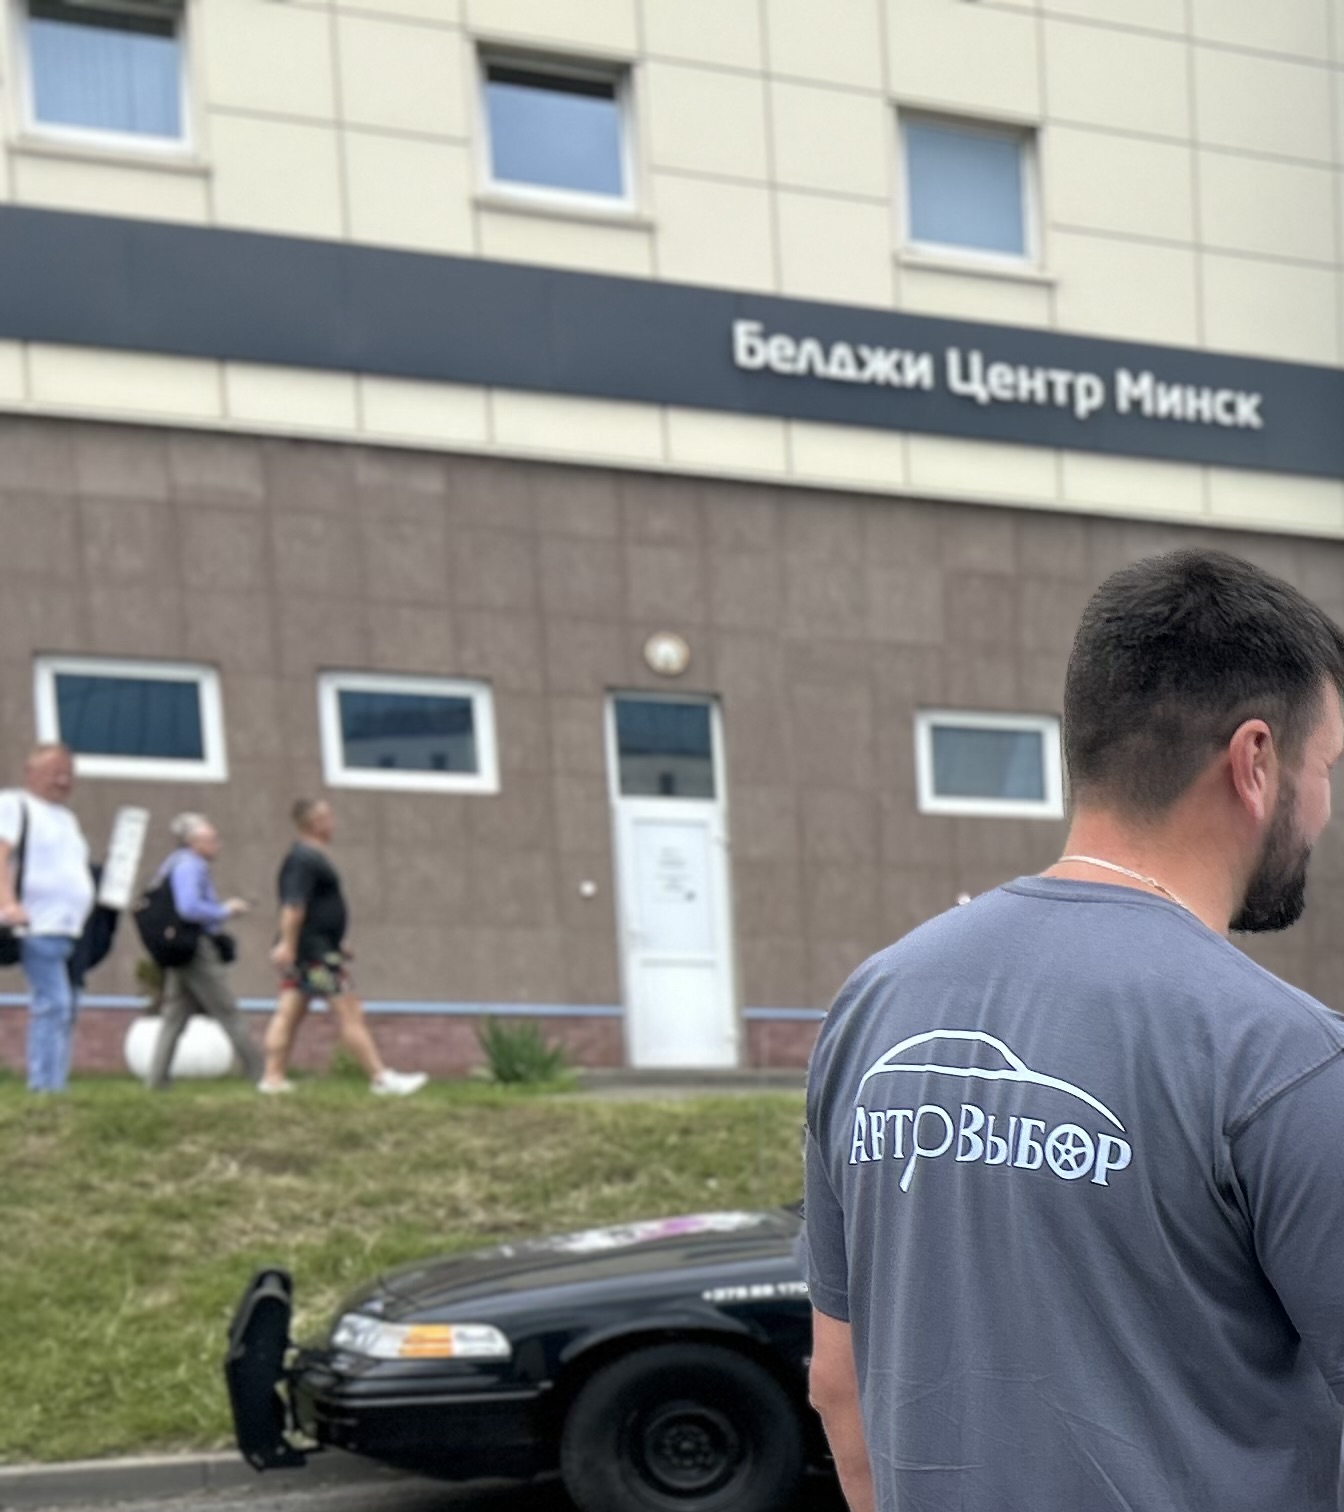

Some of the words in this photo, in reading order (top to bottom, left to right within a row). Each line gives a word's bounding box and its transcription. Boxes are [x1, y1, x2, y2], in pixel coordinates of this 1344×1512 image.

[732, 319, 934, 391] Белджи
[945, 347, 1105, 421] Центр
[1116, 367, 1264, 429] Минск
